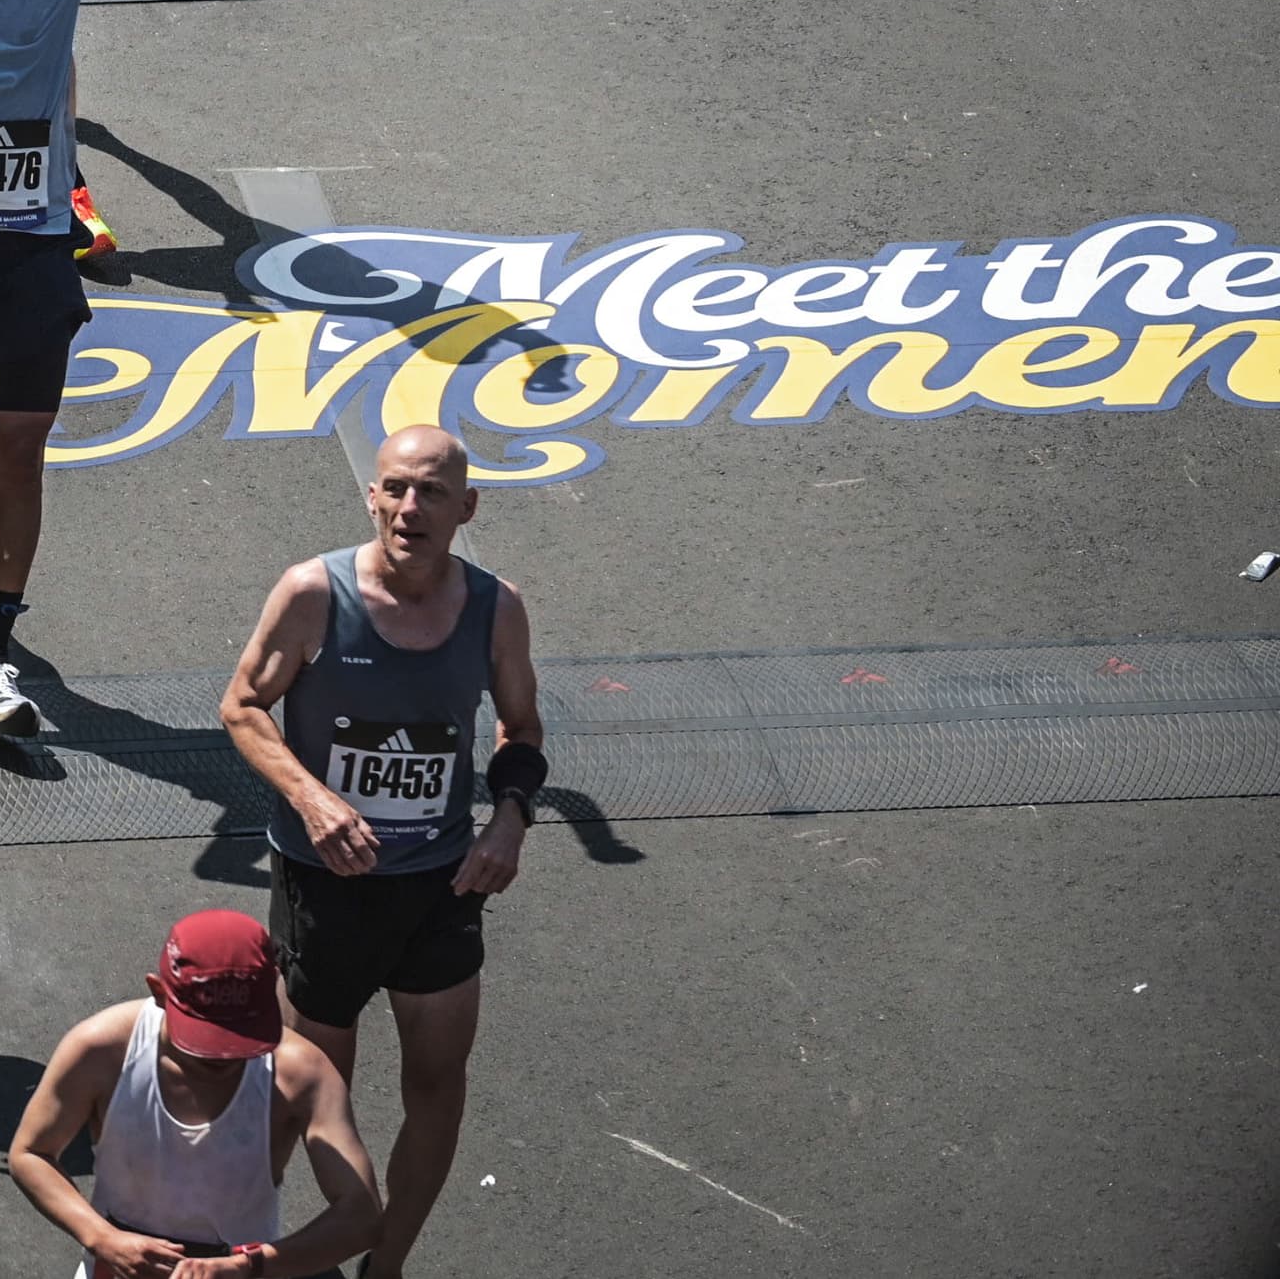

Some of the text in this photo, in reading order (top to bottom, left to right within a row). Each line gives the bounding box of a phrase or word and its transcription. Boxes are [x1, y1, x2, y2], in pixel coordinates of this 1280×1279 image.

[253, 220, 1280, 370] Meet the
[341, 753, 446, 800] 16453
